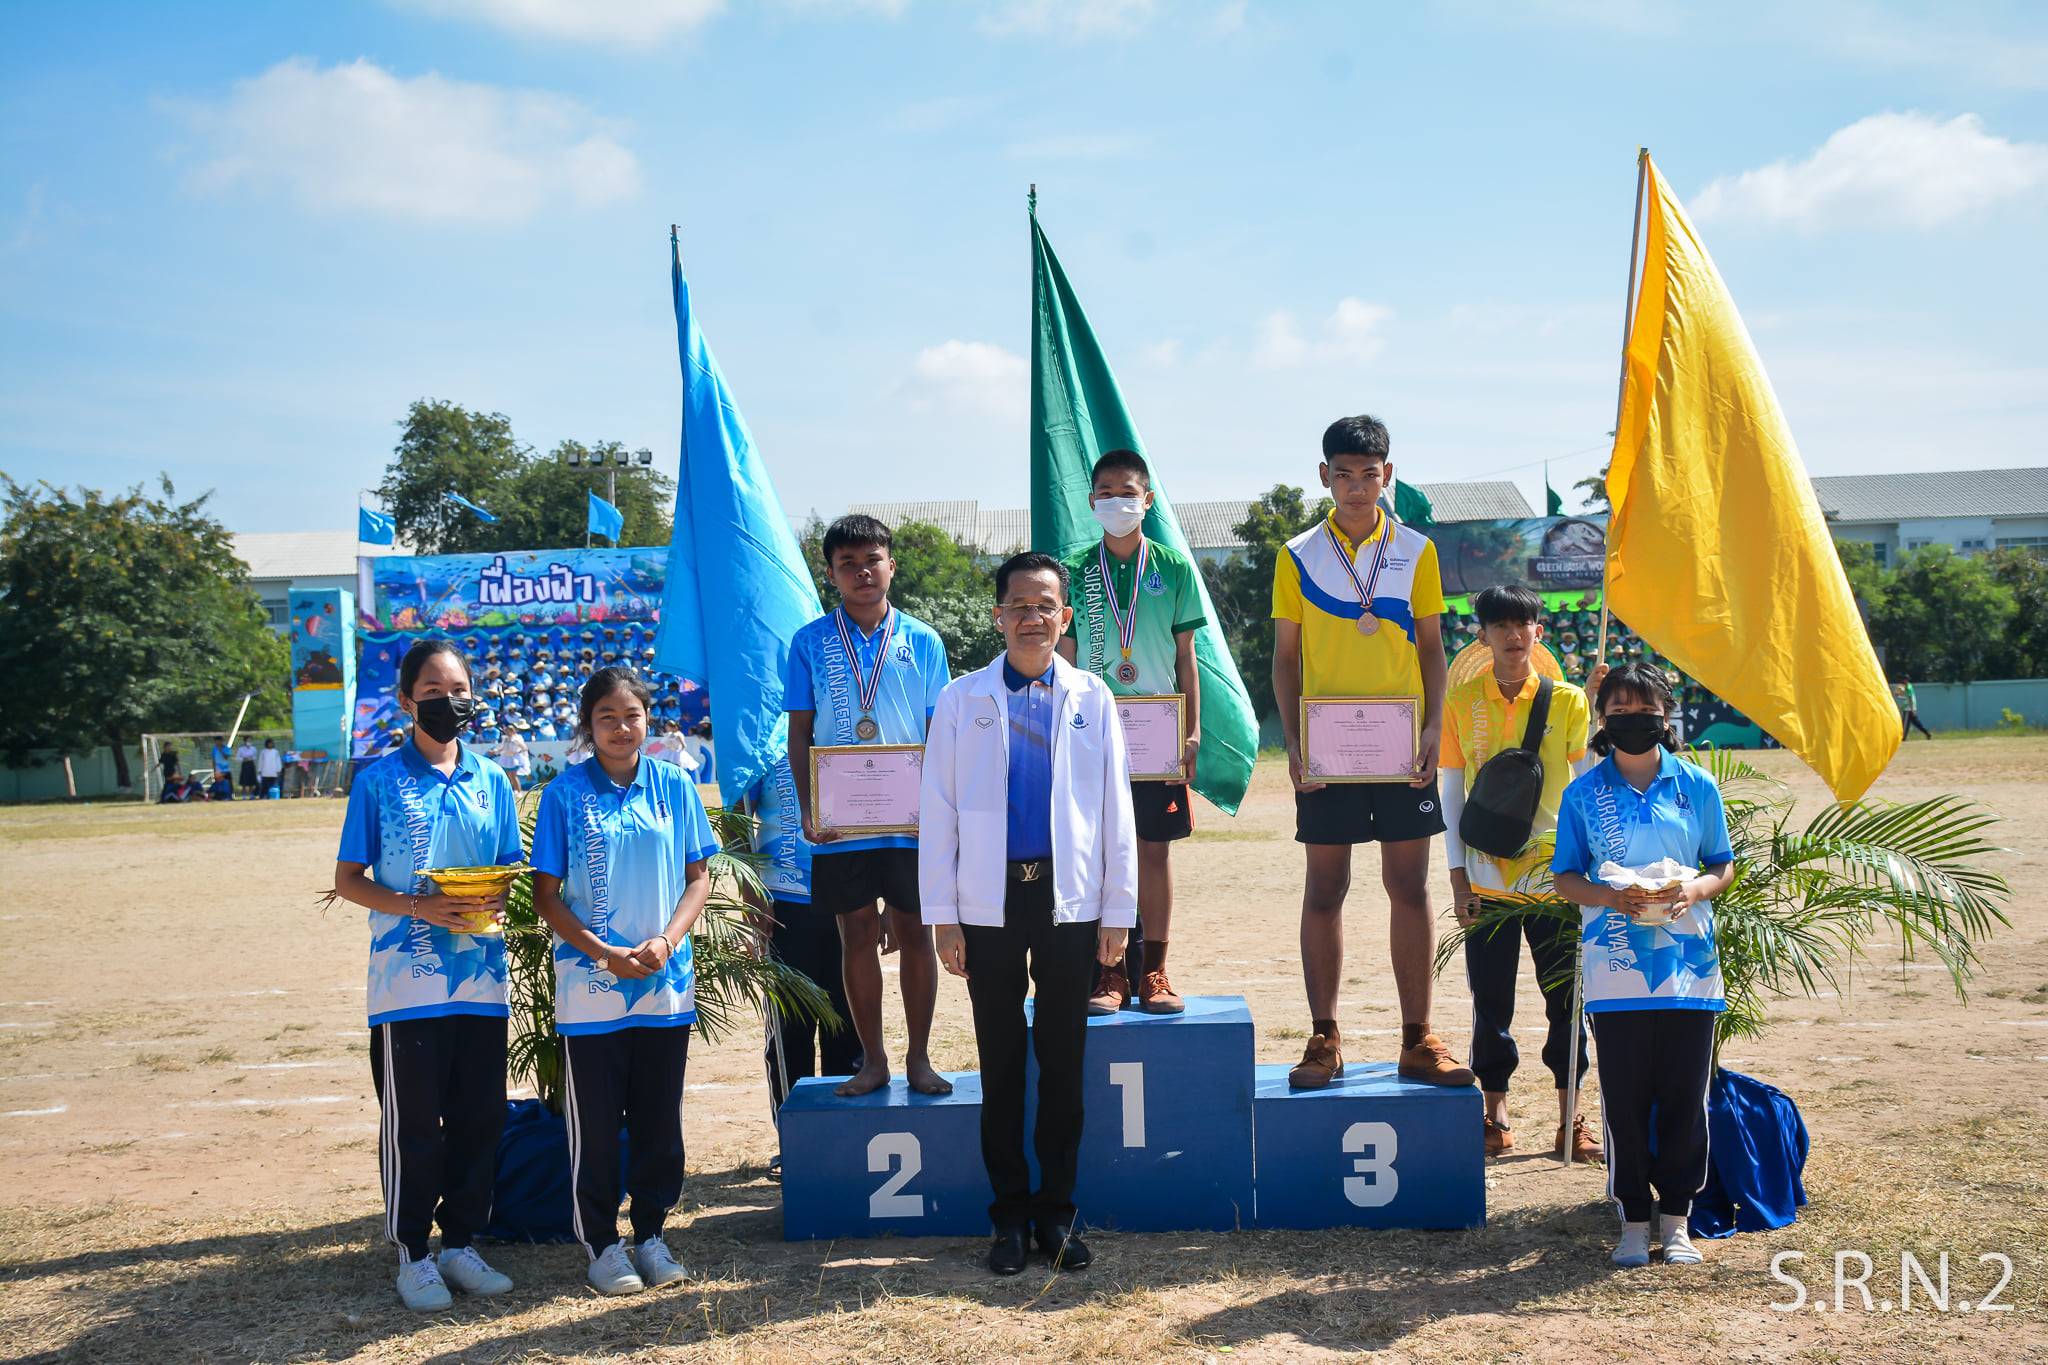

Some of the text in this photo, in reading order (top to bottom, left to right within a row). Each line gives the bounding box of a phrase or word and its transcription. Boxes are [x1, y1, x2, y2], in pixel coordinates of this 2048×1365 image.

[479, 556, 595, 606] เฟื่องฟ้า
[1084, 564, 1105, 680] SURANAREEWIT
[780, 872, 797, 884] 2
[411, 962, 436, 979] 2
[588, 979, 611, 994] 2
[1608, 957, 1631, 973] 2
[1109, 1062, 1146, 1148] 1
[867, 1132, 925, 1218] 2
[1341, 1121, 1399, 1207] 3
